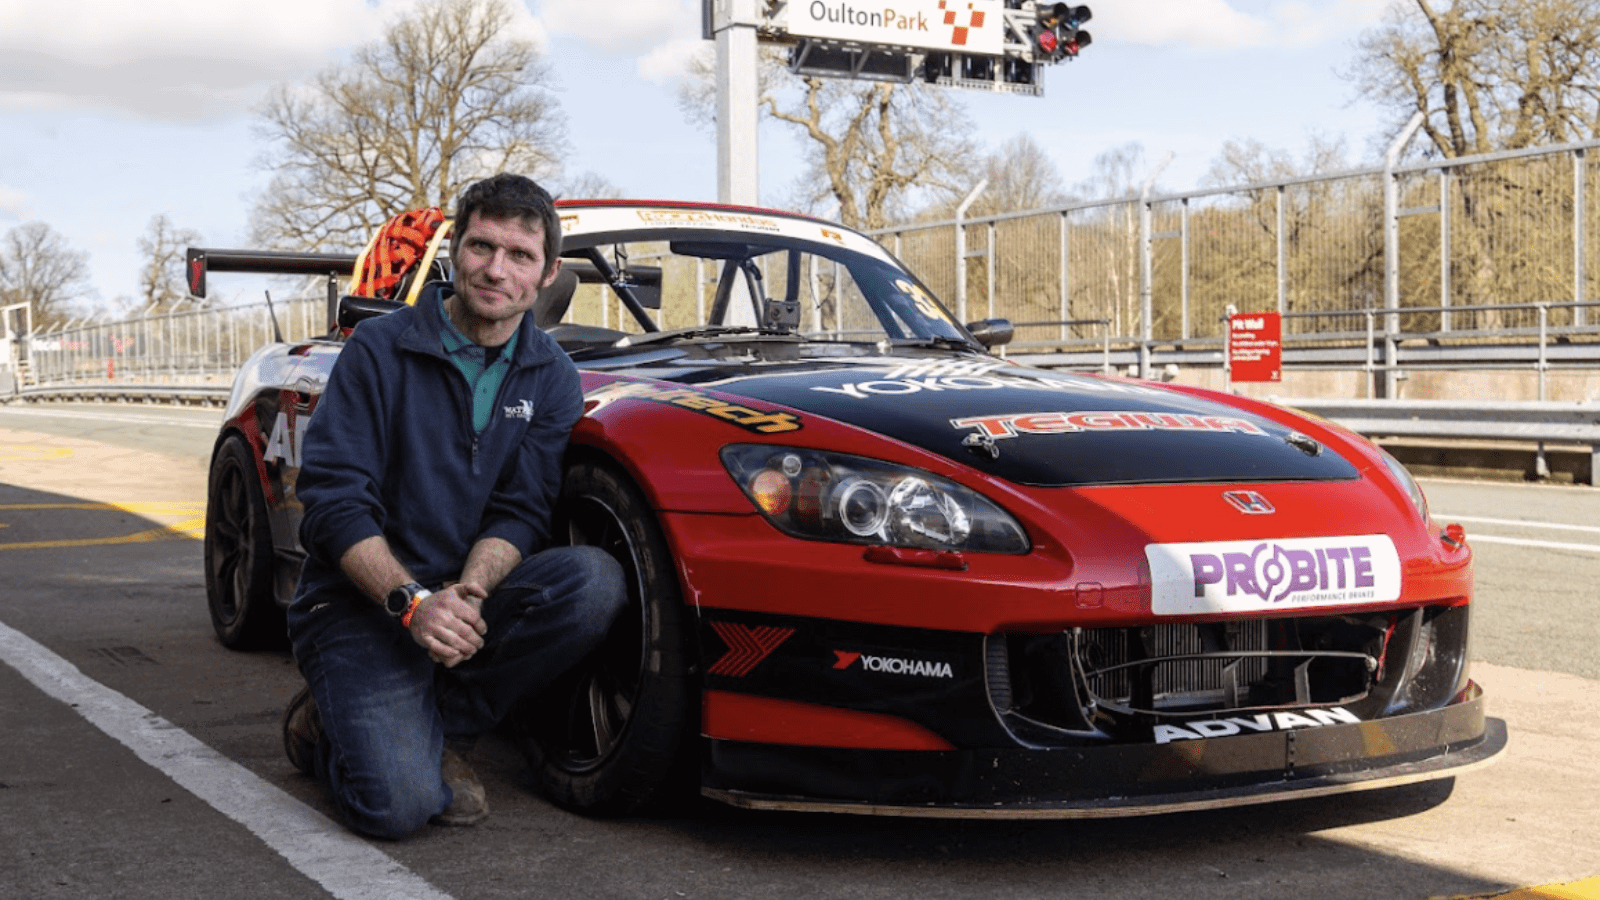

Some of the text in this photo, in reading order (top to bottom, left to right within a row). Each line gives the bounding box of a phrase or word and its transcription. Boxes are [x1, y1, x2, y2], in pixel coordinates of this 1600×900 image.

[949, 411, 1271, 439] TEGIWA
[1291, 590, 1375, 603] PERFORMANCE BRAKES
[860, 654, 954, 679] YOKOHAMA
[1153, 706, 1362, 745] ADVAN
